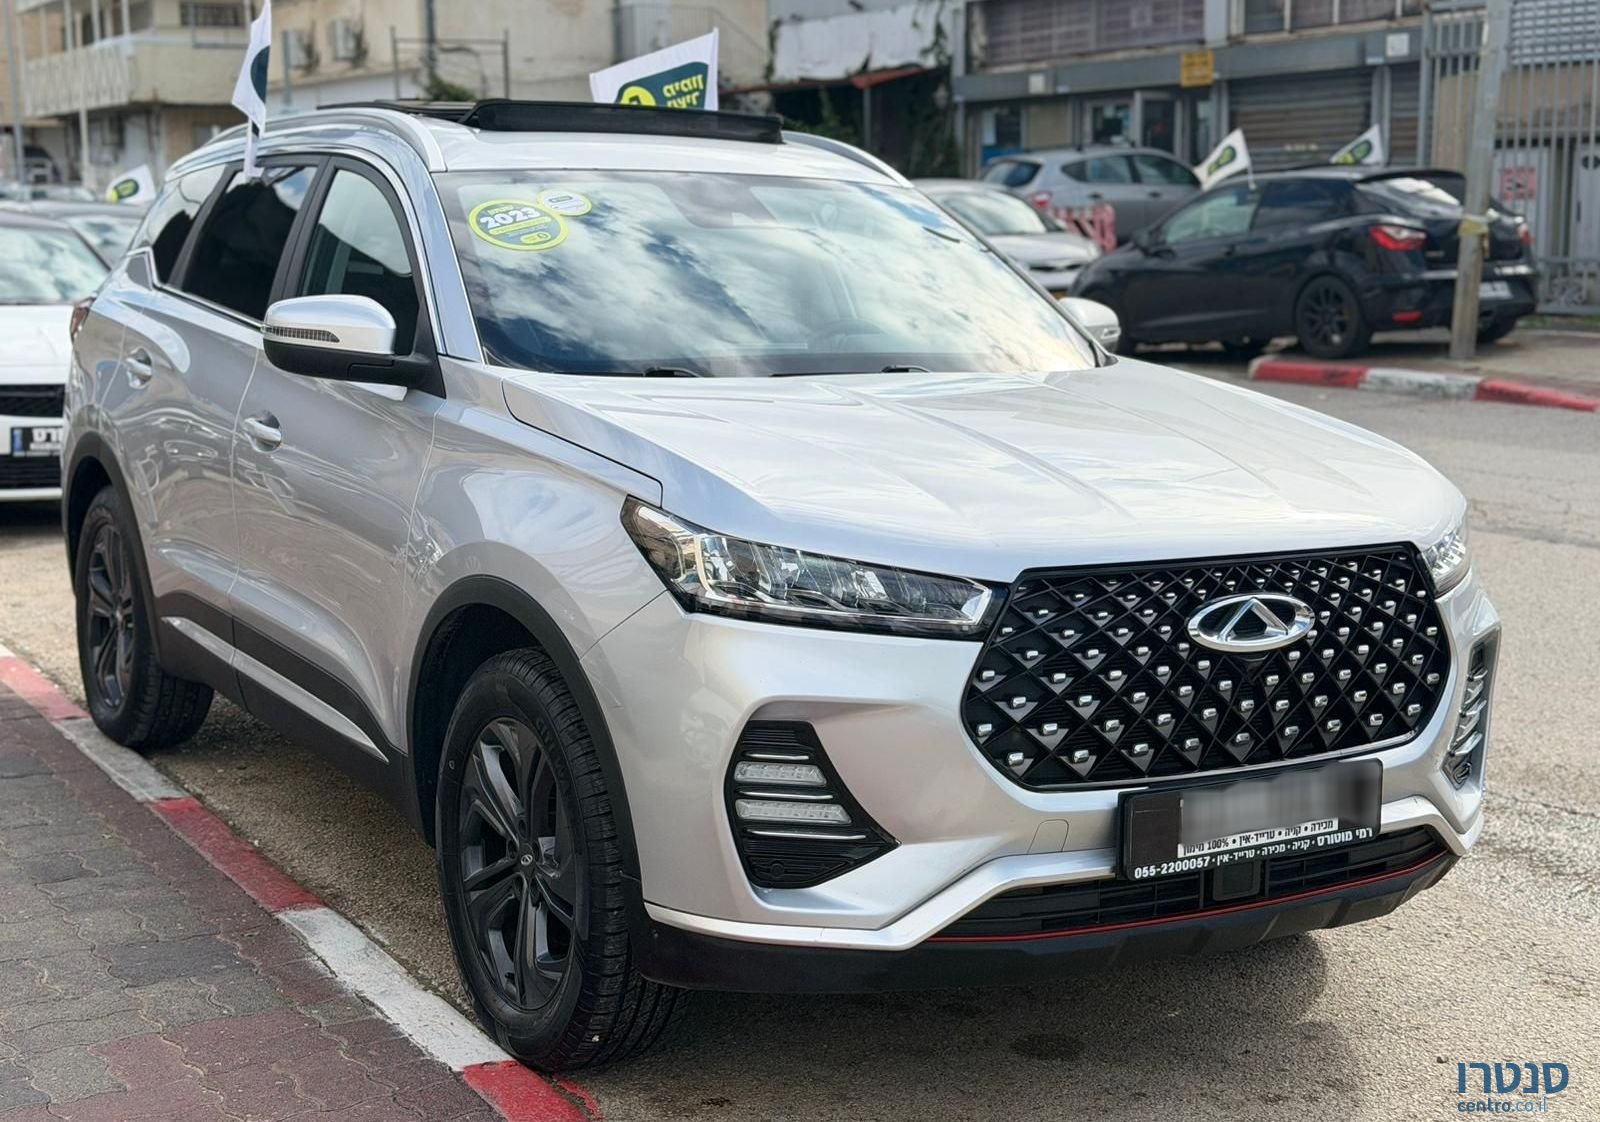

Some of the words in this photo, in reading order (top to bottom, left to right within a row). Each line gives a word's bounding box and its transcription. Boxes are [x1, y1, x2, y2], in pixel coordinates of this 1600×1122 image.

[480, 206, 541, 229] 2023
[1284, 825, 1302, 838] קניה
[1310, 819, 1334, 832] מכירה
[1238, 829, 1276, 846] טרייד-אין
[1317, 831, 1353, 846] מוטורס
[1355, 827, 1374, 839] רמי
[1183, 841, 1205, 856] מימון
[1207, 837, 1229, 851] 100%
[1261, 844, 1286, 857] מכירה
[1292, 840, 1310, 853] קניה
[1216, 849, 1256, 866] טרייד-אין
[1134, 856, 1211, 878] 055-2200057
